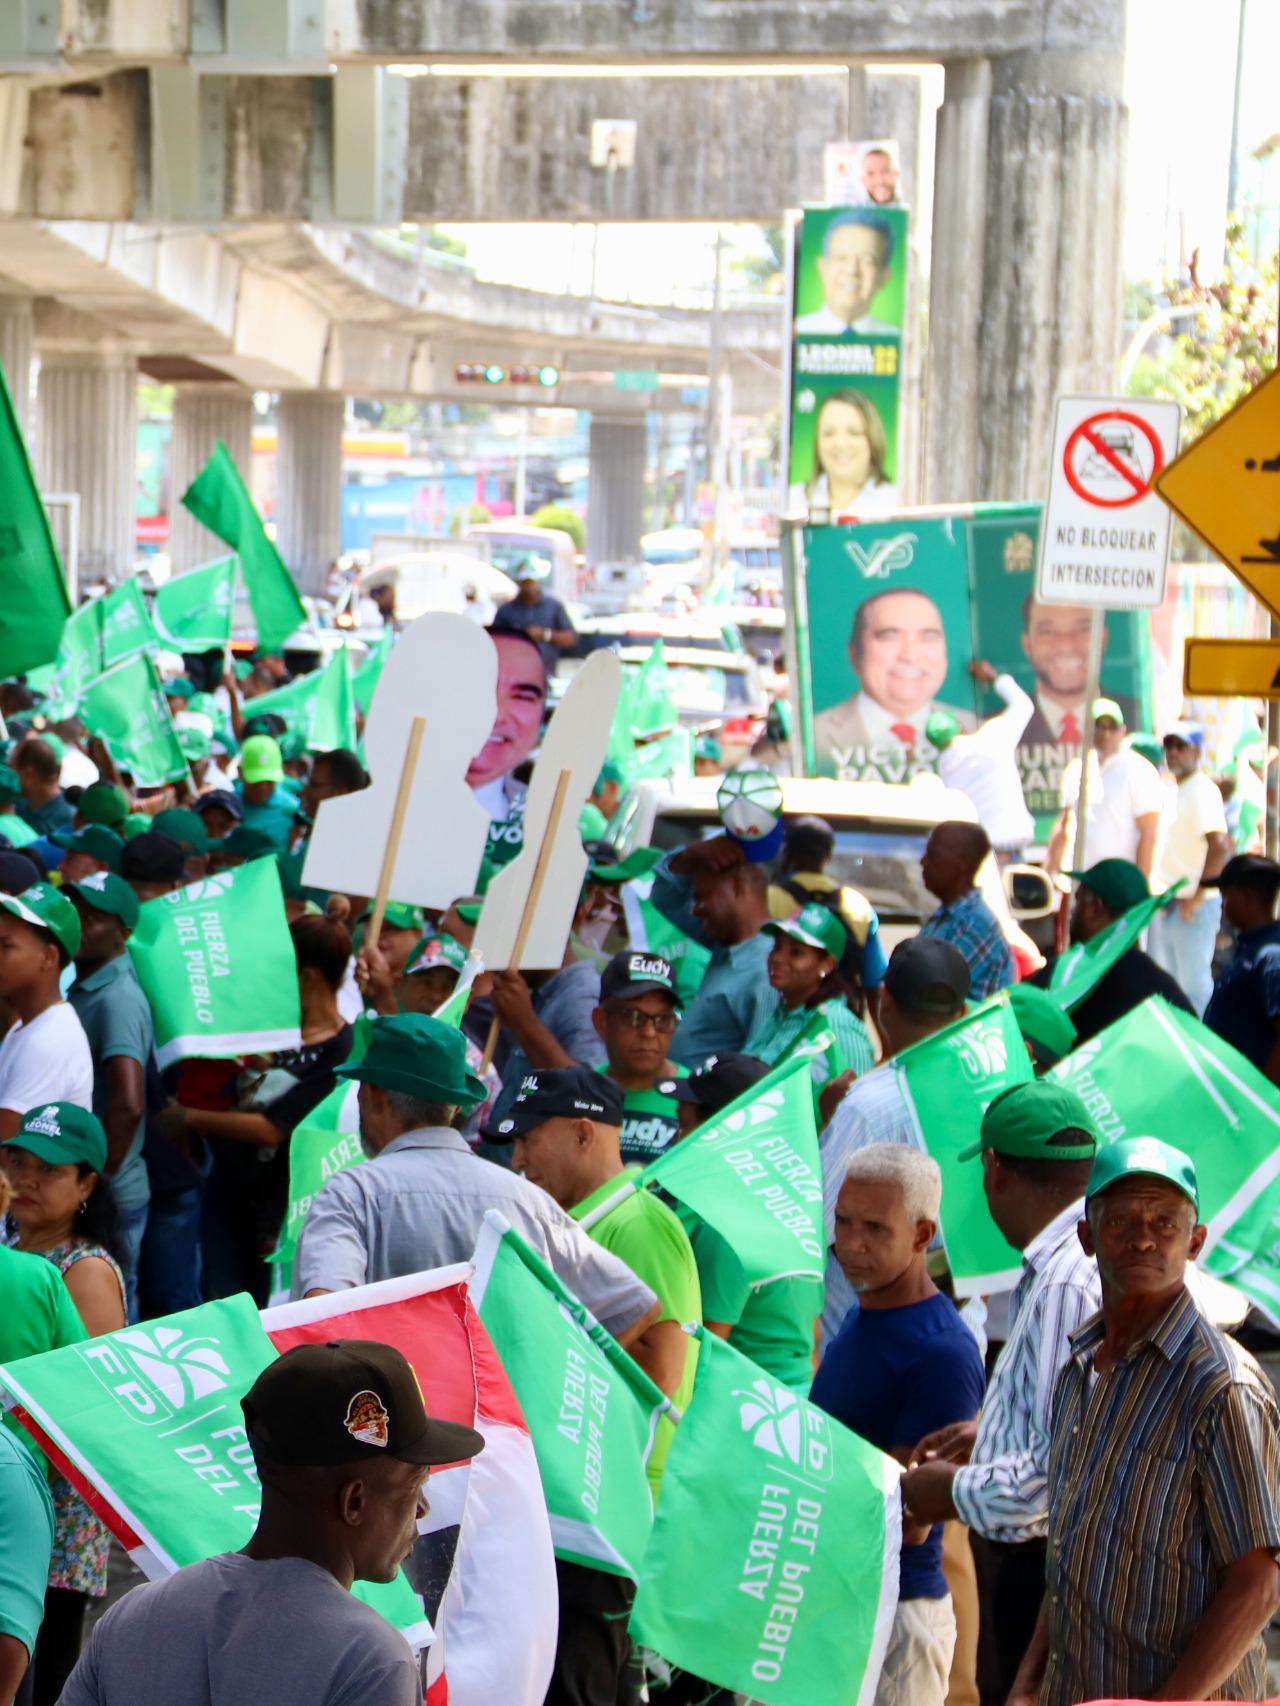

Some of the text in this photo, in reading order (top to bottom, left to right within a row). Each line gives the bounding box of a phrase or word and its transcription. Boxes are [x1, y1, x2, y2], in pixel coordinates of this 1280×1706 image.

[798, 344, 872, 362] LEONEL
[1057, 526, 1156, 551] NO BLOQUEAR
[1051, 563, 1155, 590] INTERSECCION
[831, 744, 939, 767] VICTO
[174, 915, 214, 1024] DEL PUEBLO
[200, 911, 230, 977] FUERZA
[630, 954, 671, 978] Eudy
[620, 1118, 678, 1148] udy
[1073, 1071, 1127, 1145] FUERZA
[755, 1136, 823, 1202] FUERZA
[723, 1148, 823, 1259] DEL PUEBLO
[84, 1344, 157, 1414] FP
[174, 1443, 240, 1496] DEL
